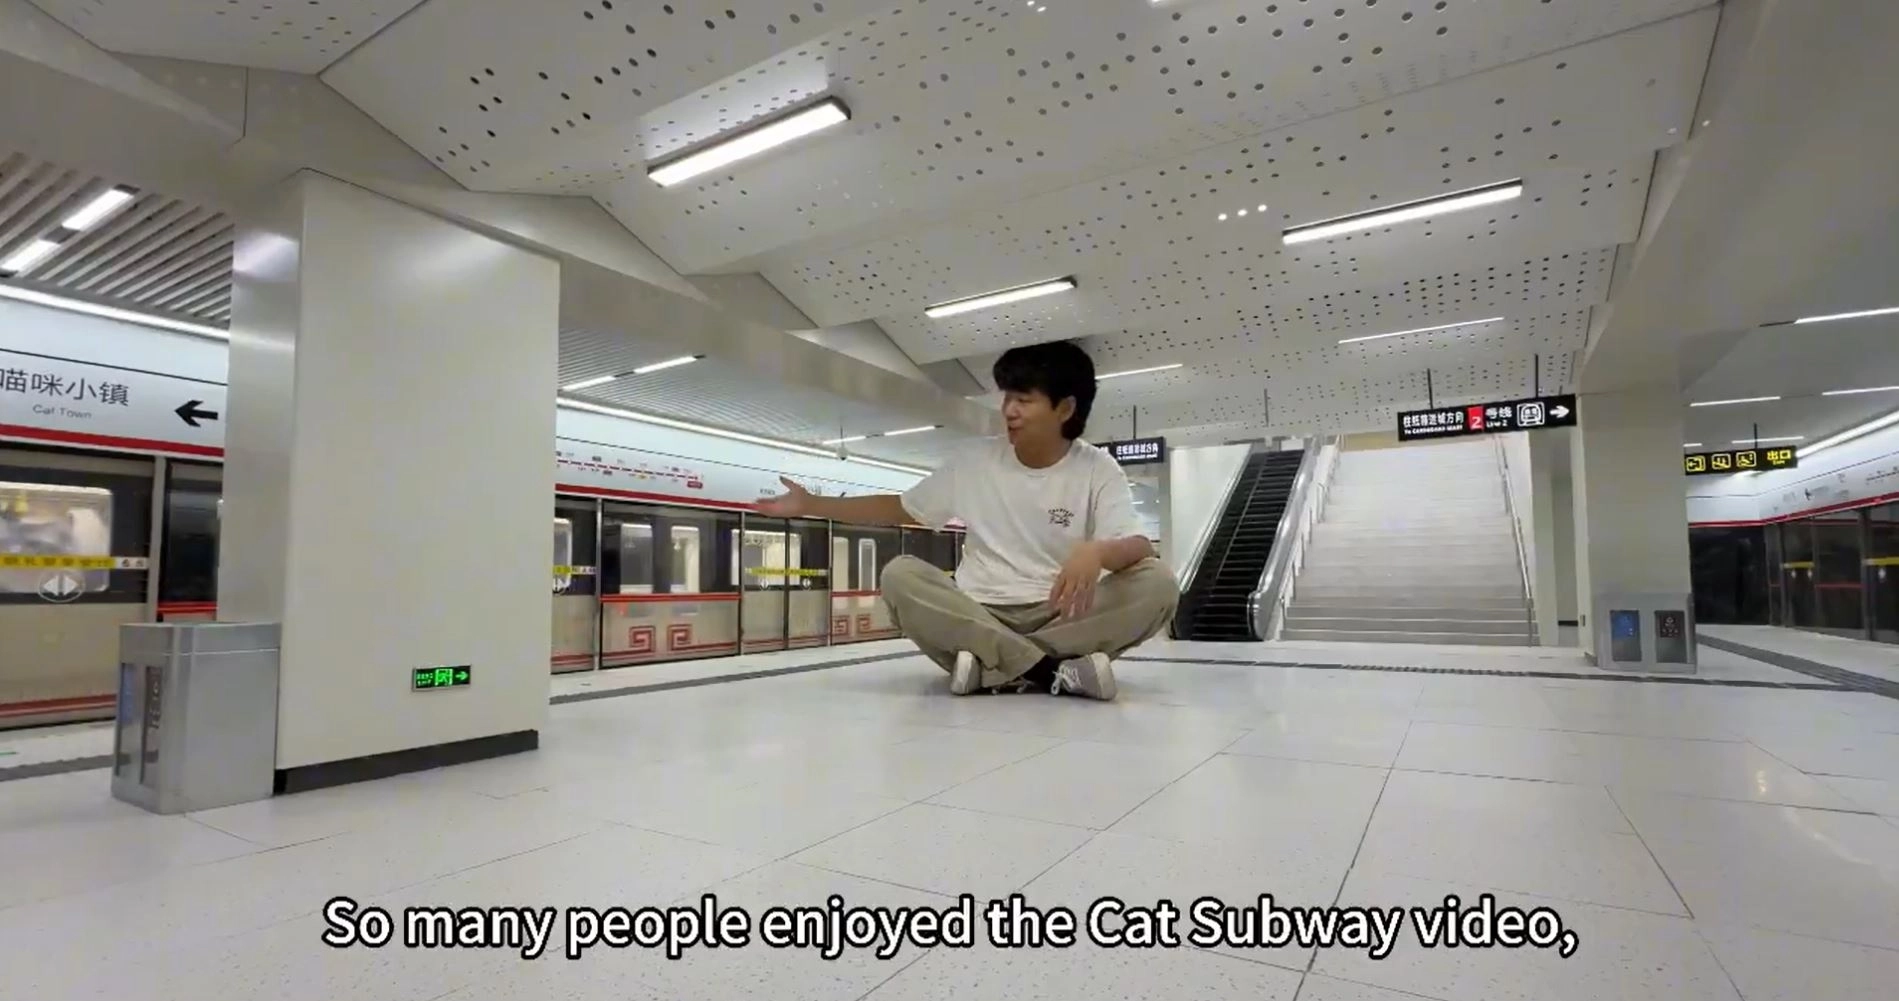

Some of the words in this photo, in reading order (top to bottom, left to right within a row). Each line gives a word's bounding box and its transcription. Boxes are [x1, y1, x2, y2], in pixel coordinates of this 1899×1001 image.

[0, 368, 129, 407] 喵咪小镇
[32, 404, 55, 415] Cat
[60, 407, 92, 419] Town
[1471, 416, 1483, 430] 2
[1485, 406, 1512, 419] 号线
[1766, 449, 1792, 461] 出口
